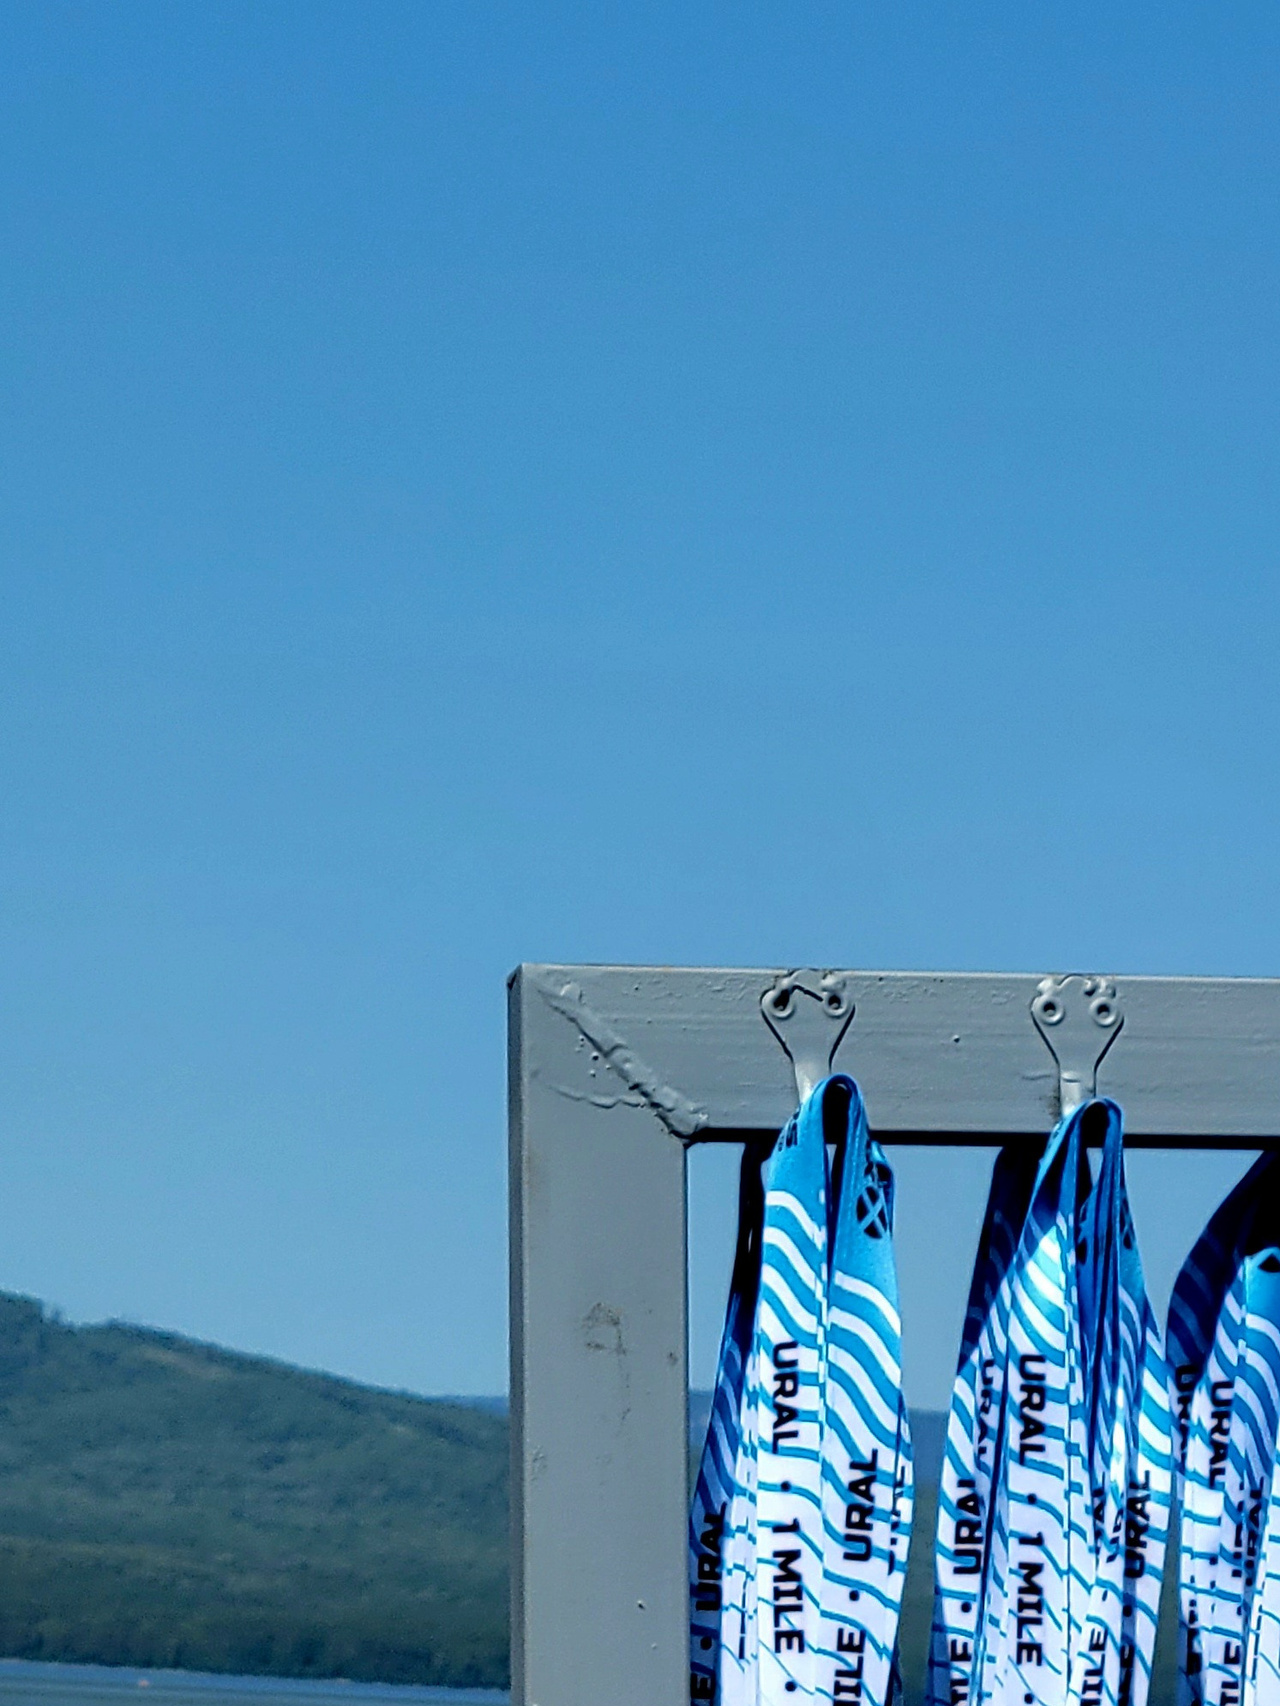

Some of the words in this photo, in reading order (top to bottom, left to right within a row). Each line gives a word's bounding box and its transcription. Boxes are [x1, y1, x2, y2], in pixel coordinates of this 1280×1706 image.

[773, 1341, 798, 1454] URAL
[1020, 1355, 1046, 1465] URAL
[1209, 1381, 1234, 1488] URAL
[772, 1518, 799, 1532] 1
[843, 1449, 878, 1561] URAL
[1019, 1532, 1043, 1546] 1
[1124, 1470, 1150, 1578] URAL
[772, 1550, 805, 1653] MILE
[1016, 1562, 1044, 1666] MILE
